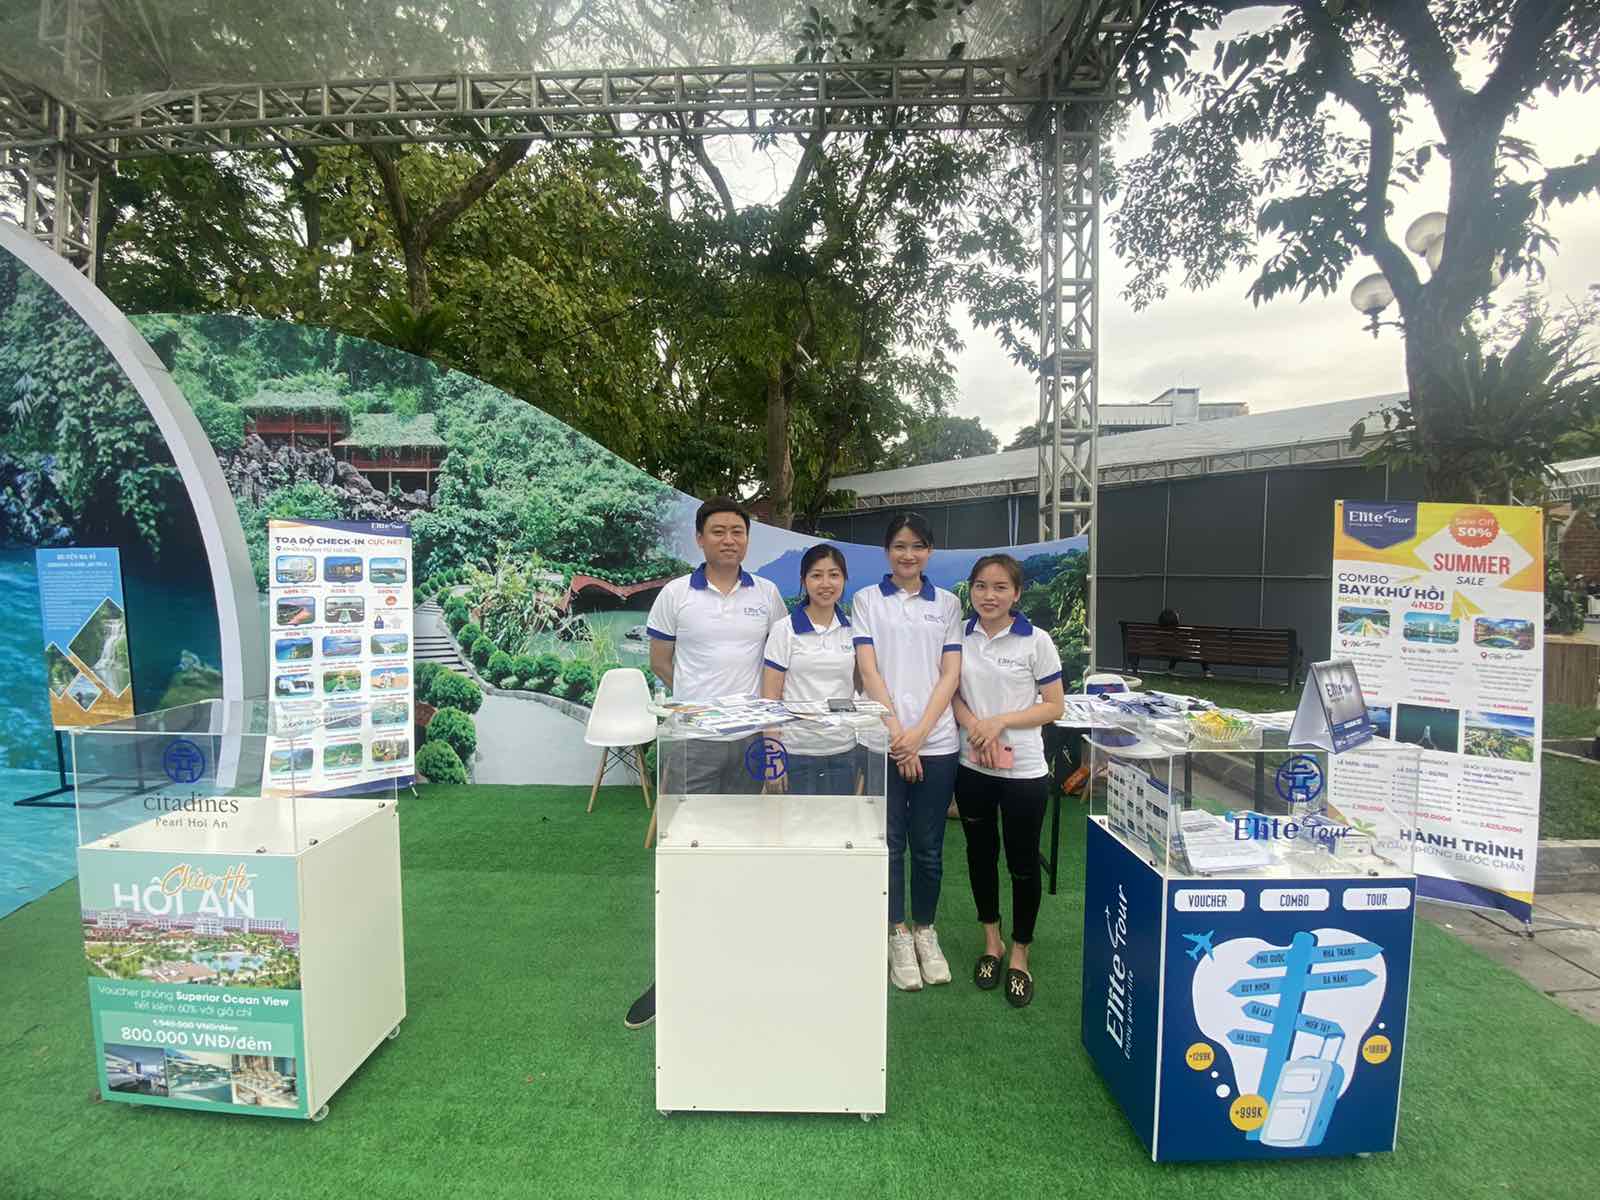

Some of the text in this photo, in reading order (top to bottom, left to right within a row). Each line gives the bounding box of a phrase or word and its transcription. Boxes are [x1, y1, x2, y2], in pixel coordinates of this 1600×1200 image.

[1349, 510, 1384, 523] Elite
[1457, 526, 1493, 538] 50%
[316, 537, 365, 546] CHECK-IN
[1433, 552, 1511, 575] SUMMER
[1338, 573, 1389, 585] COMBO
[1456, 575, 1486, 586] SALE
[1339, 584, 1445, 601] BAY KHỨ HỒI
[143, 791, 240, 814] citadines
[155, 817, 229, 829] Pearl Hoi An
[1234, 816, 1354, 842] Elite Tour
[1399, 827, 1524, 861] HÀNH TRÌNH
[1188, 894, 1228, 908] VOUCHER
[1279, 893, 1309, 907] COMBO
[1366, 893, 1388, 907] TOUR
[97, 983, 290, 1008] Voucher phòng Superior Ocean View
[1106, 953, 1126, 1049] Elite
[120, 1026, 274, 1053] 800.000 VNĐ/đêm
